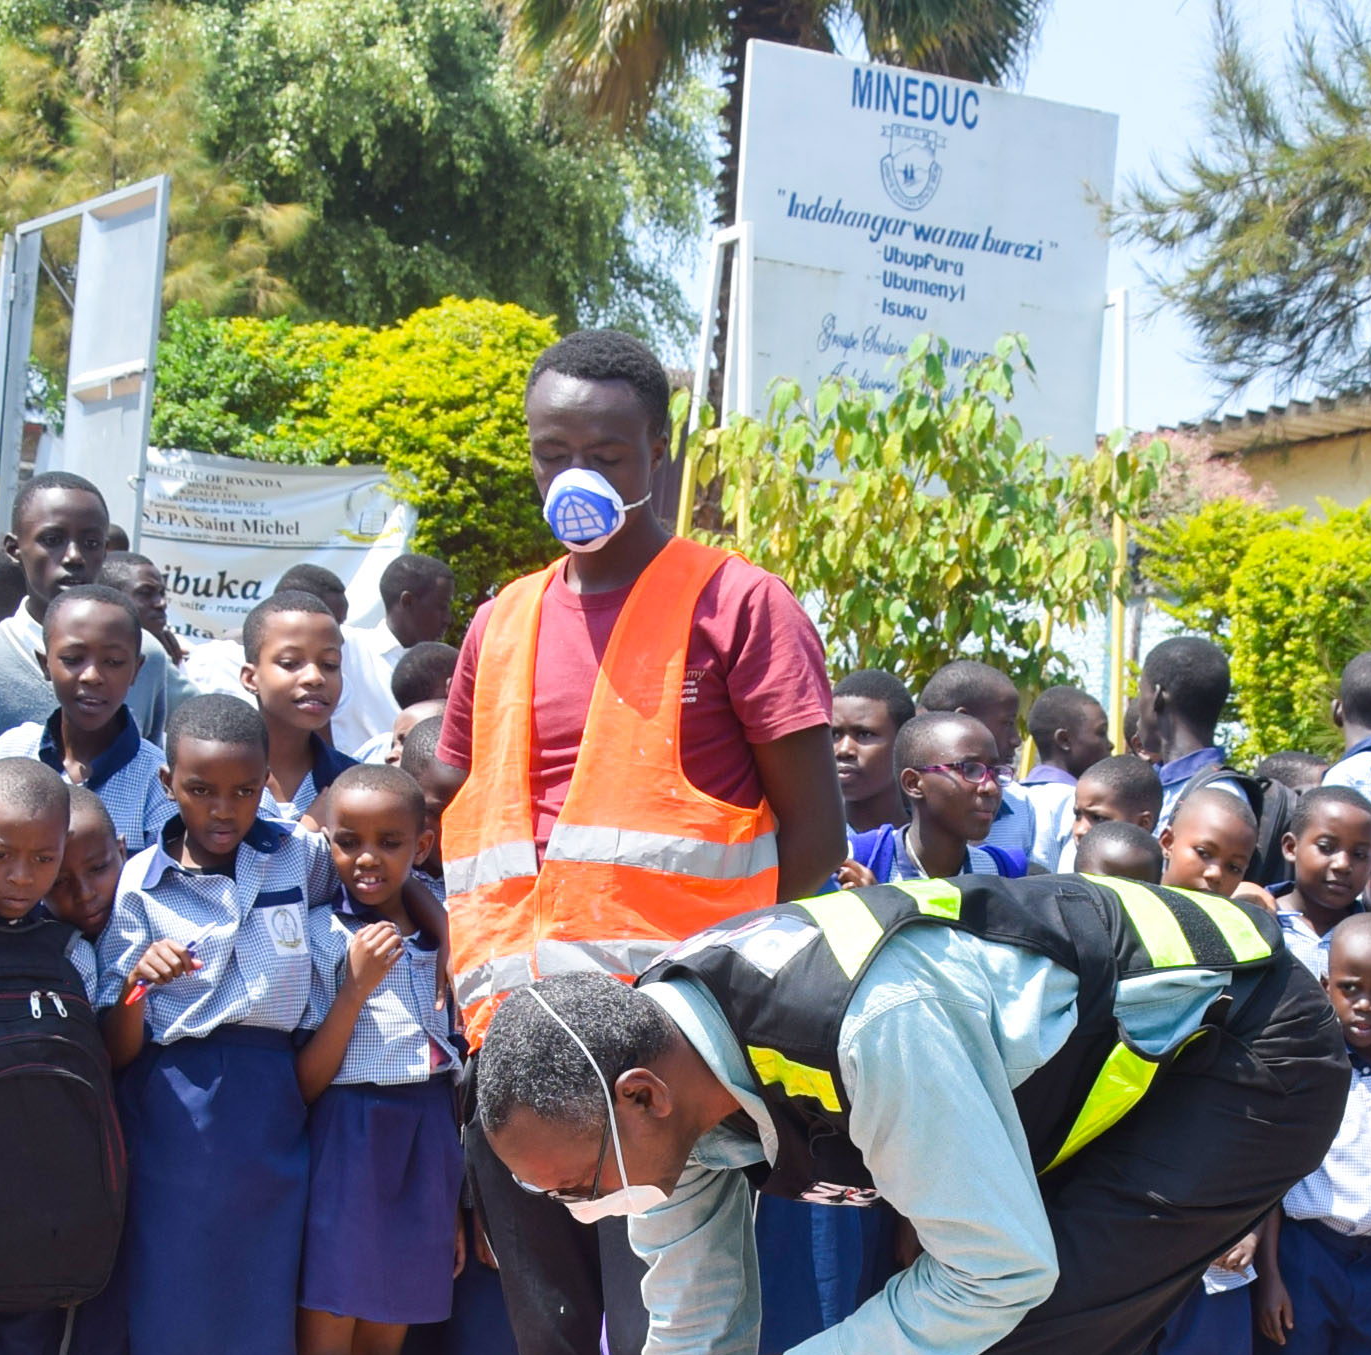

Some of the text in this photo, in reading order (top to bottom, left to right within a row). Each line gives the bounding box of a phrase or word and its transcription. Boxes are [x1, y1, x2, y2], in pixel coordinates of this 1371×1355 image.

[851, 67, 980, 130] MINEDUC
[226, 477, 283, 489] RWANDA
[194, 515, 235, 533] Saint
[241, 519, 300, 535] Michel
[162, 564, 263, 600] ibuka
